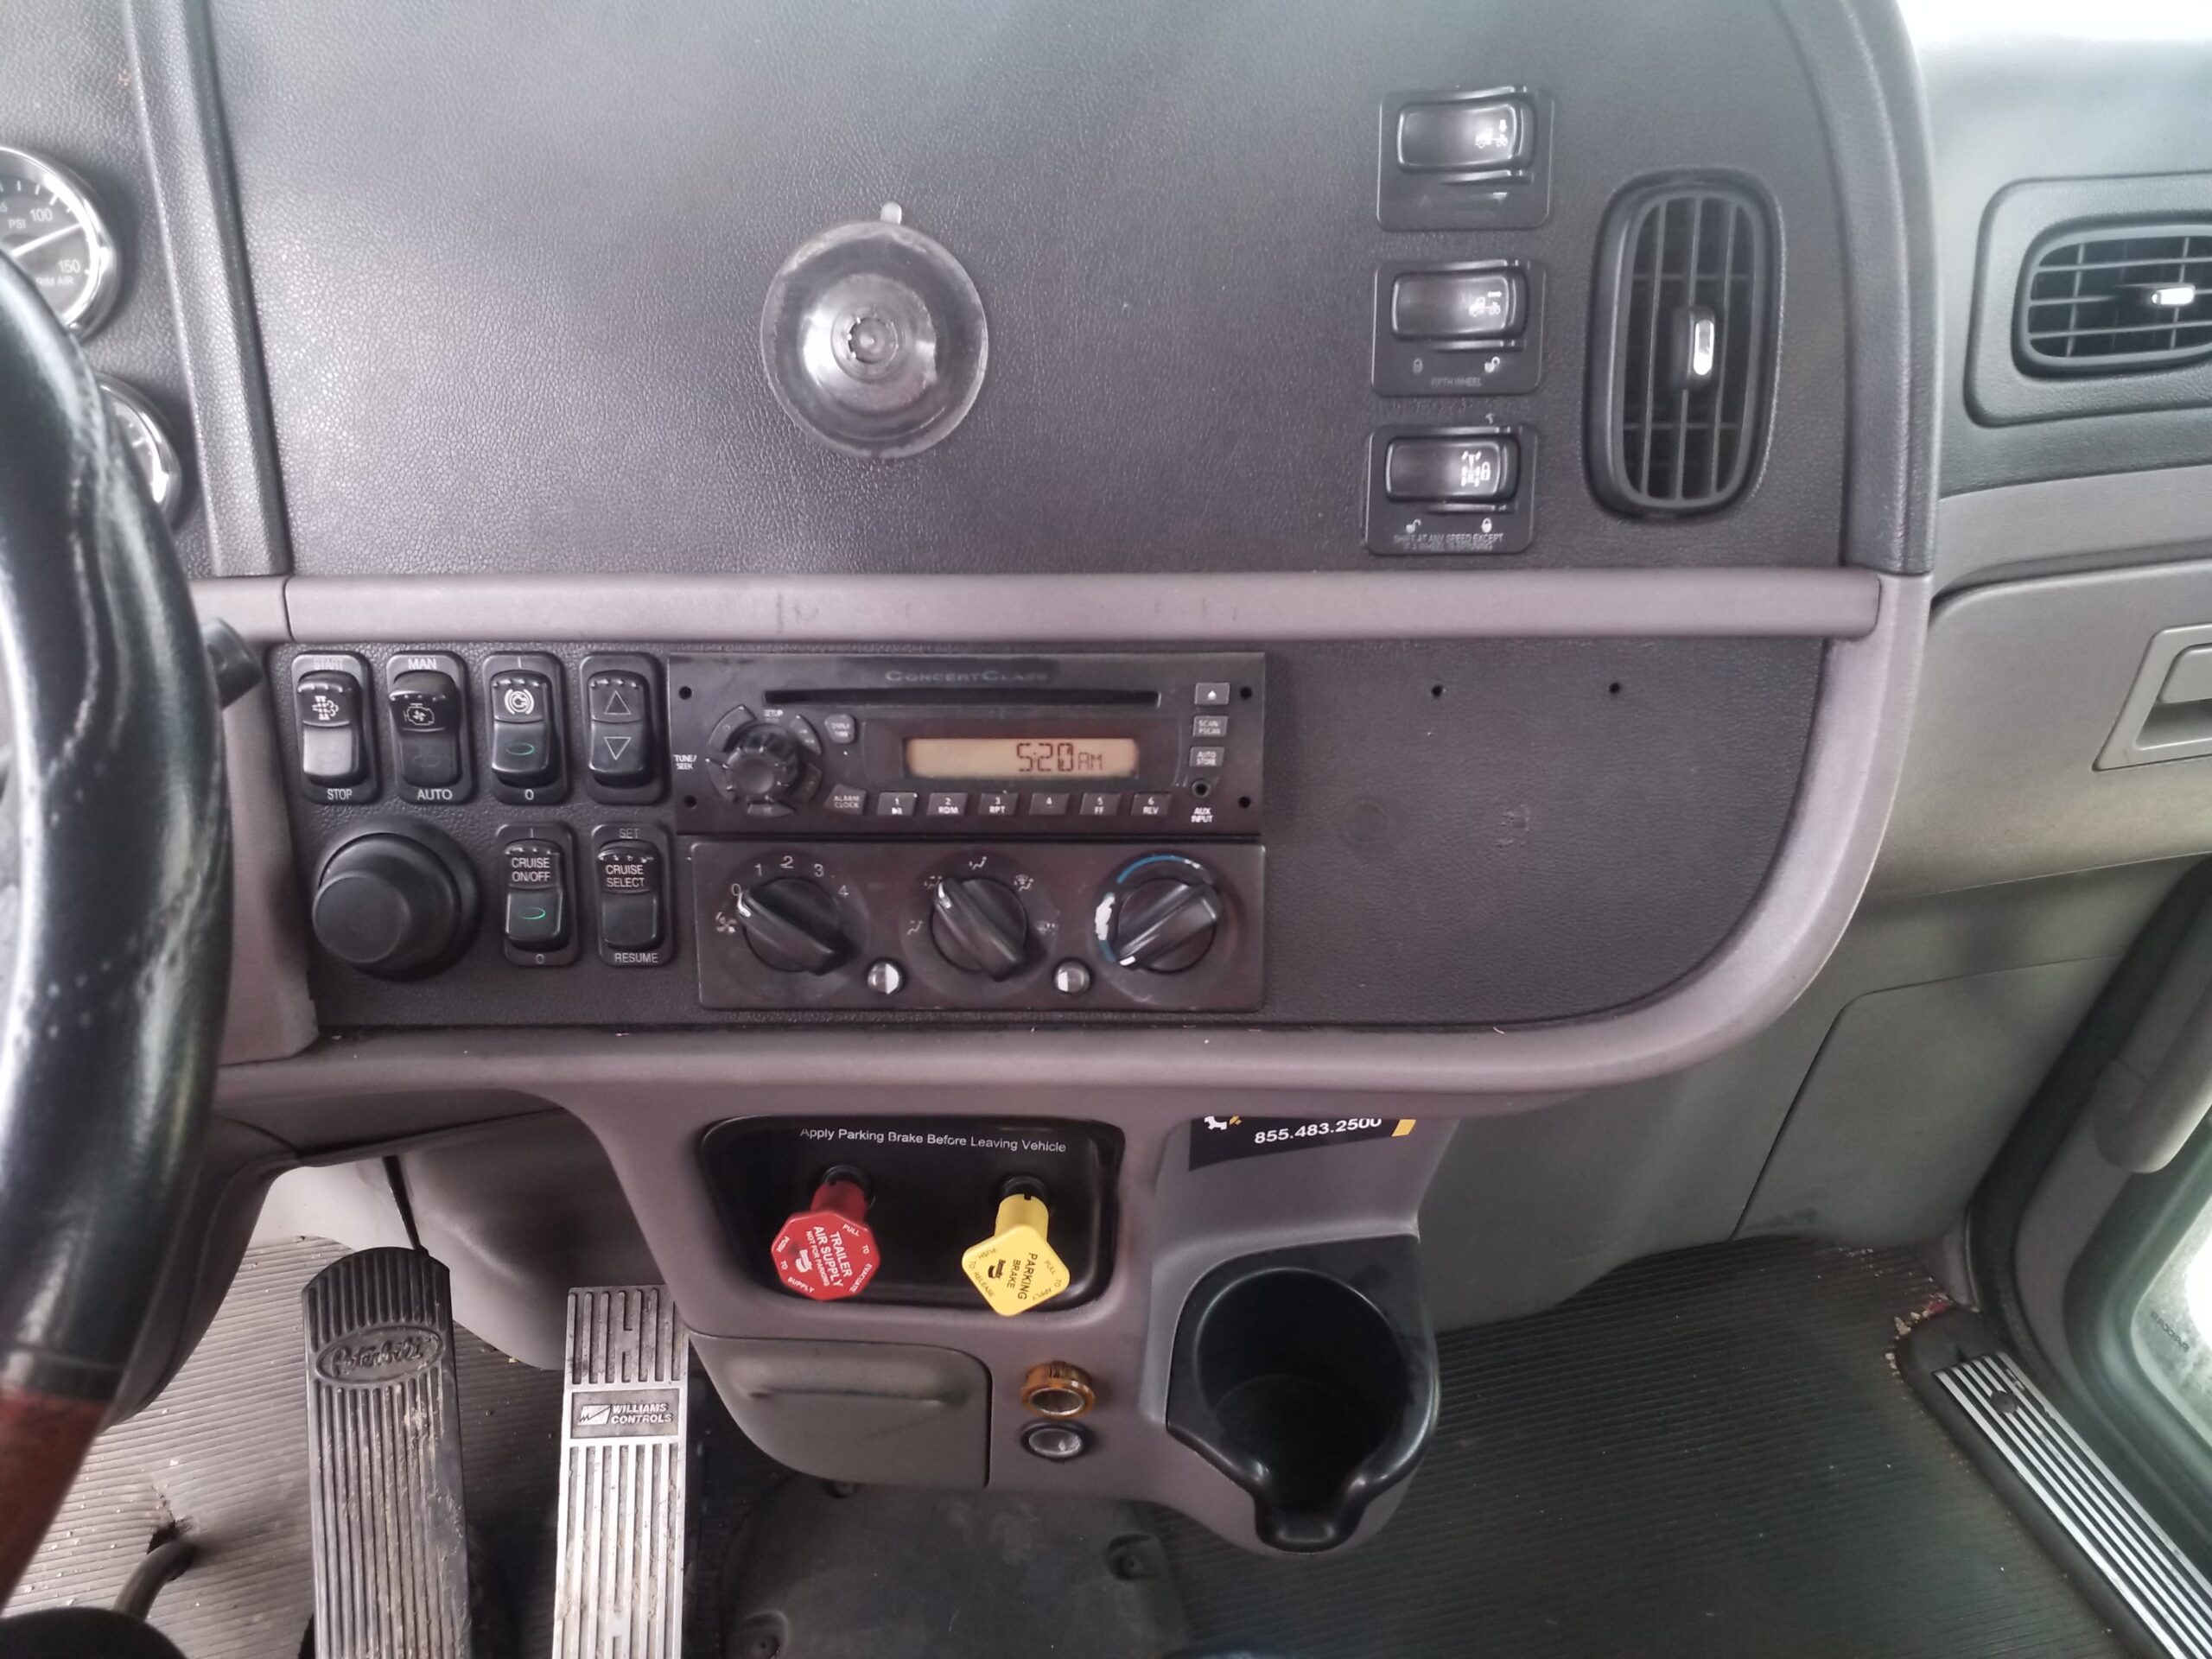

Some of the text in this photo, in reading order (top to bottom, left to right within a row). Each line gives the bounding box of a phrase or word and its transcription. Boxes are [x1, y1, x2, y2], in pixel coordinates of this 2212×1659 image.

[30, 208, 53, 222] 100
[8, 219, 26, 228] PSI
[58, 259, 81, 273] 150
[313, 658, 344, 671] START
[408, 658, 437, 670] MAN
[1078, 752, 1103, 770] AM
[327, 788, 353, 800] STOP
[417, 789, 453, 800] AUTO
[894, 797, 899, 805] 1
[1046, 797, 1052, 805] 4
[1094, 806, 1104, 815] FF
[1142, 806, 1159, 815] REV
[619, 828, 640, 839] SET
[511, 857, 550, 868] CRUISE
[779, 855, 794, 869] 2
[512, 871, 551, 882] ON/OFF
[606, 864, 644, 875] CRUISE
[754, 863, 762, 876] 1
[814, 863, 824, 877] 3
[607, 877, 645, 888] SELECT
[838, 884, 849, 898] 4
[614, 952, 658, 963] RESUME
[1254, 1118, 1382, 1144] 855.483.2500
[800, 1128, 1066, 1153] Apply Parking Brake Before Leaving Vehicle
[776, 1236, 791, 1253] PUSH
[805, 1230, 817, 1245] NOT
[810, 1244, 820, 1259] FOR
[813, 1225, 844, 1287] AIR SUPPLY
[830, 1230, 854, 1278] TRAILER
[780, 1260, 788, 1270] TO
[842, 1224, 873, 1294] PULL TO EVACUATE
[815, 1257, 831, 1287] PARKING
[969, 1247, 997, 1298] PUSH TO RELEASE
[1007, 1259, 1021, 1289] BRAKE
[1017, 1252, 1039, 1300] PARKING
[787, 1276, 816, 1294] SUPPLY
[1032, 1260, 1062, 1301] PULL TO APPLY
[612, 1402, 669, 1414] WILLIAMS
[611, 1414, 674, 1425] CONTROLS
